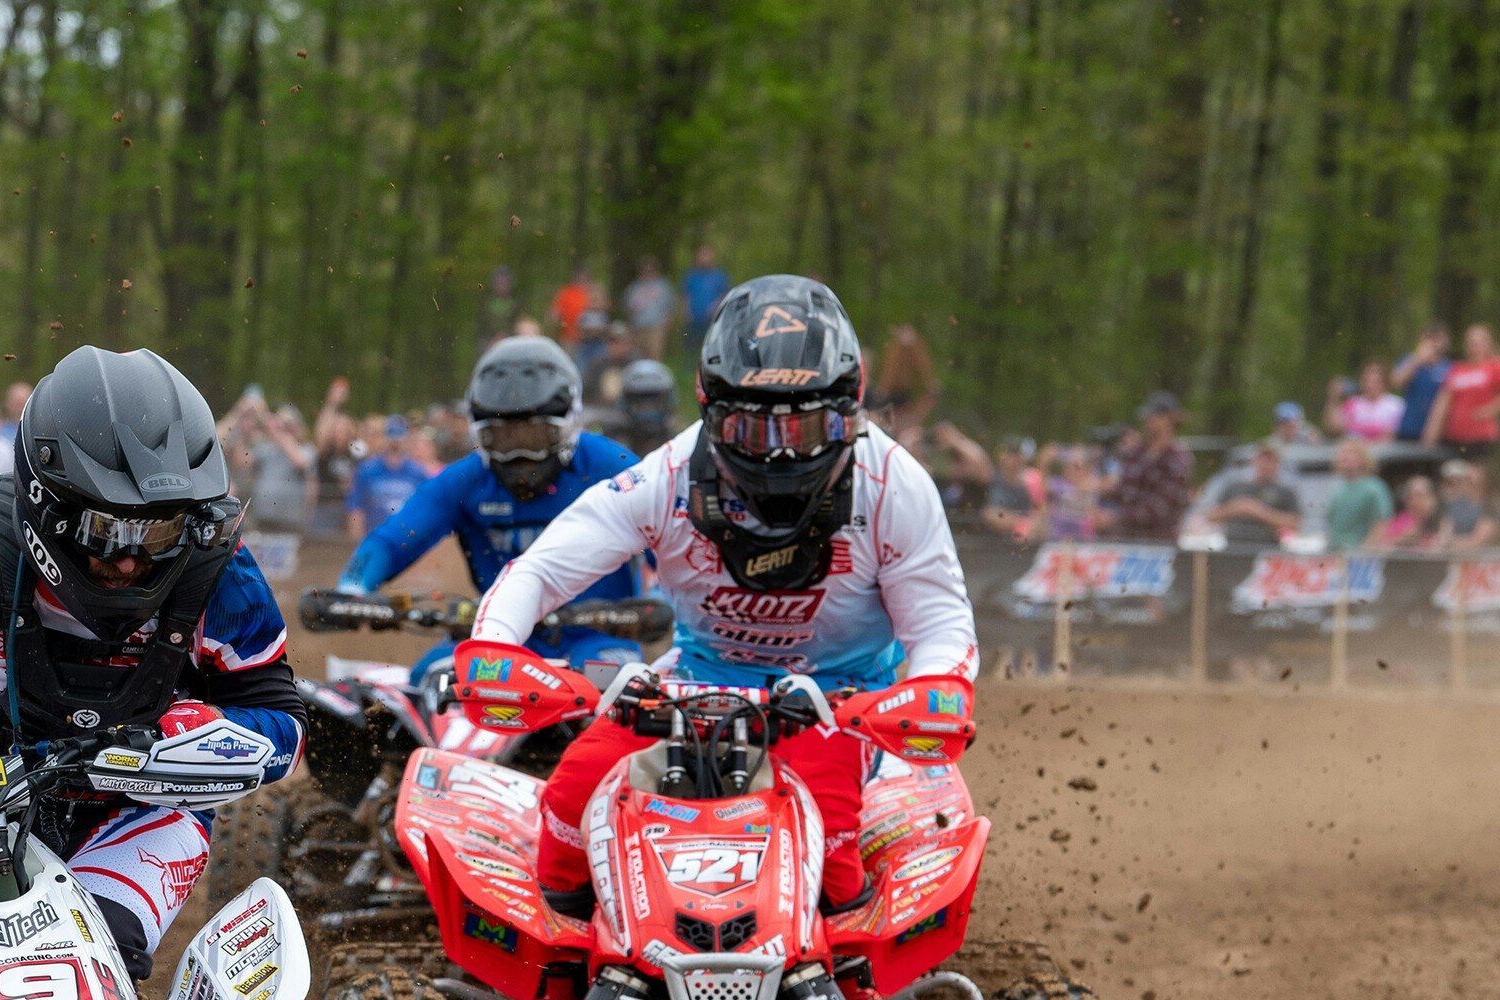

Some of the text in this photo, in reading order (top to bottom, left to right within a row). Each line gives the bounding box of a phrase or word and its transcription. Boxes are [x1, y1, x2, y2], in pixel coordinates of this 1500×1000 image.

[741, 369, 820, 388] LEATT
[148, 477, 185, 489] BELL
[746, 545, 799, 577] LEATT
[717, 591, 816, 618] KLOTZ
[106, 753, 140, 763] WORKS
[100, 778, 155, 792] MATTO CYCLE
[645, 799, 701, 822] McGill
[666, 850, 759, 884] 521
[35, 941, 77, 951] JMR
